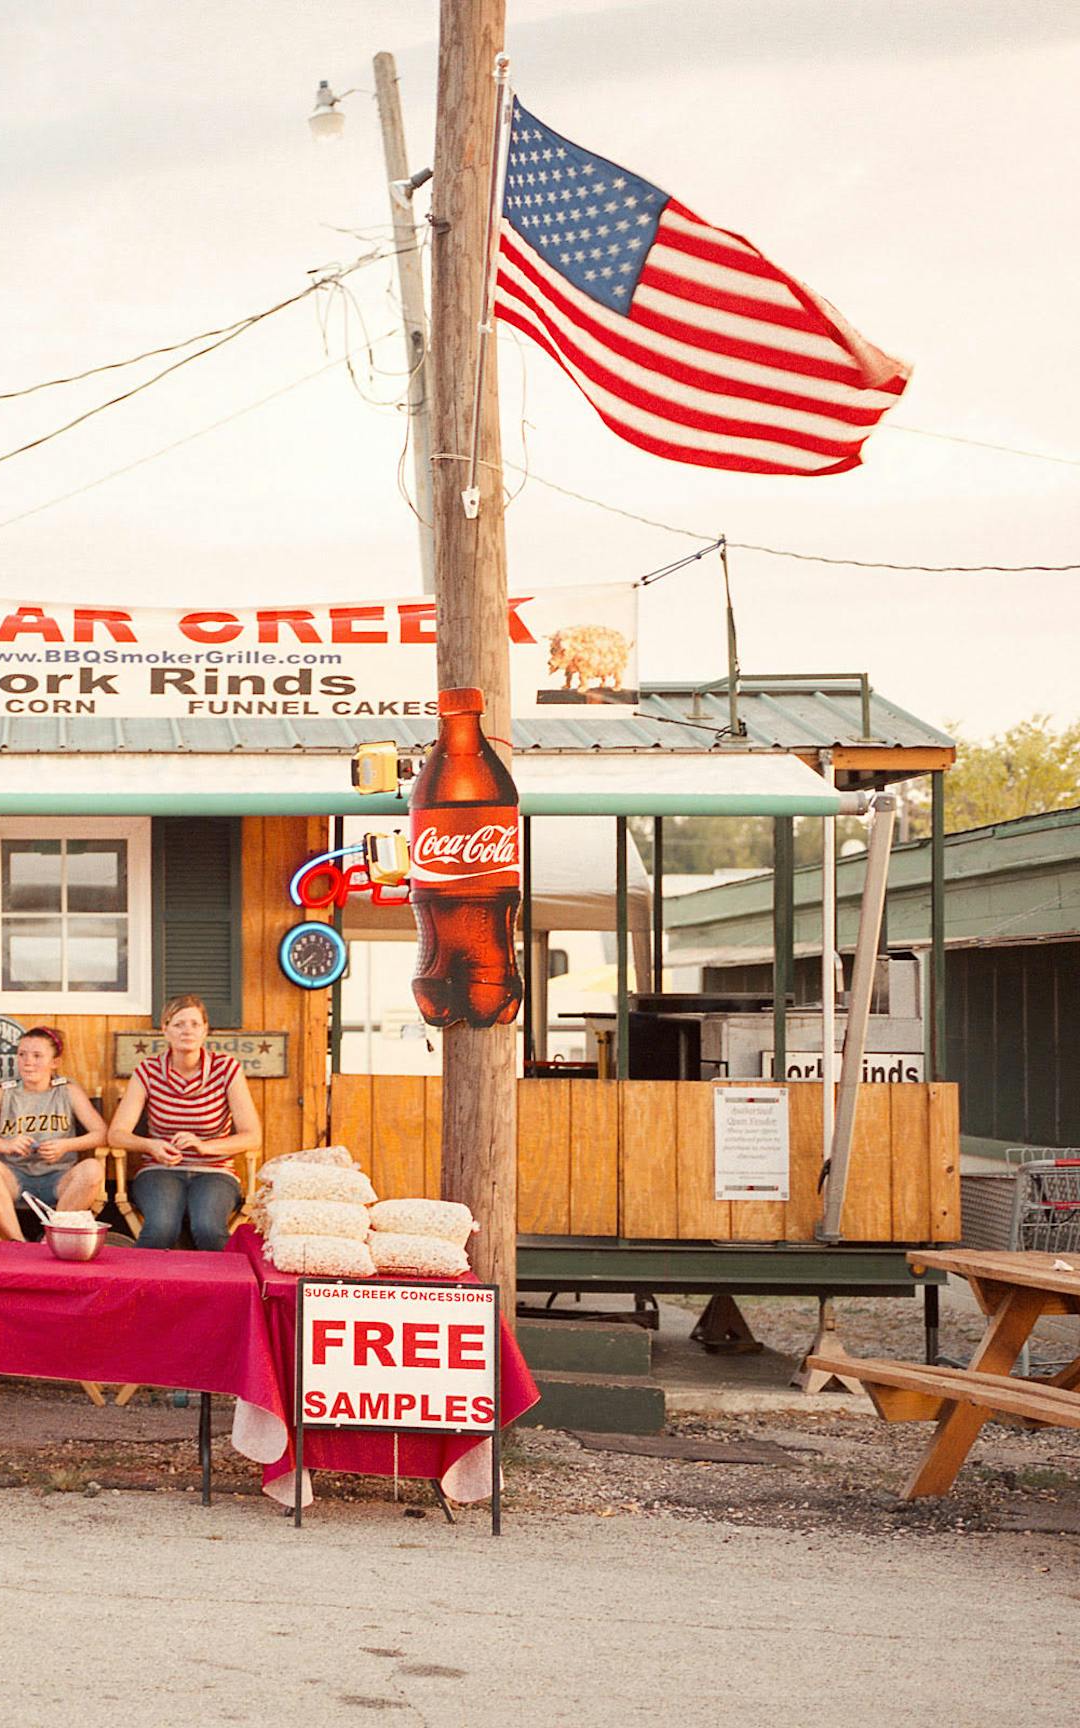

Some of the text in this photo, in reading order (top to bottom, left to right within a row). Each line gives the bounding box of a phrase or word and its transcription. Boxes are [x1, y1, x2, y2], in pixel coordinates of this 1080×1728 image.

[150, 667, 356, 695] Rinds
[5, 699, 95, 713] CORN
[188, 701, 319, 715] FUNNEL
[332, 700, 437, 716] CAKES
[414, 825, 518, 864] Coca-Cola
[152, 1038, 254, 1053] Fnds
[863, 1060, 919, 1083] inds
[1, 1114, 69, 1135] MIZZOU
[305, 1288, 493, 1303] SUGAR CREEK CONCESSIONS
[312, 1320, 486, 1370] FREE
[304, 1391, 496, 1423] SAMPLES
